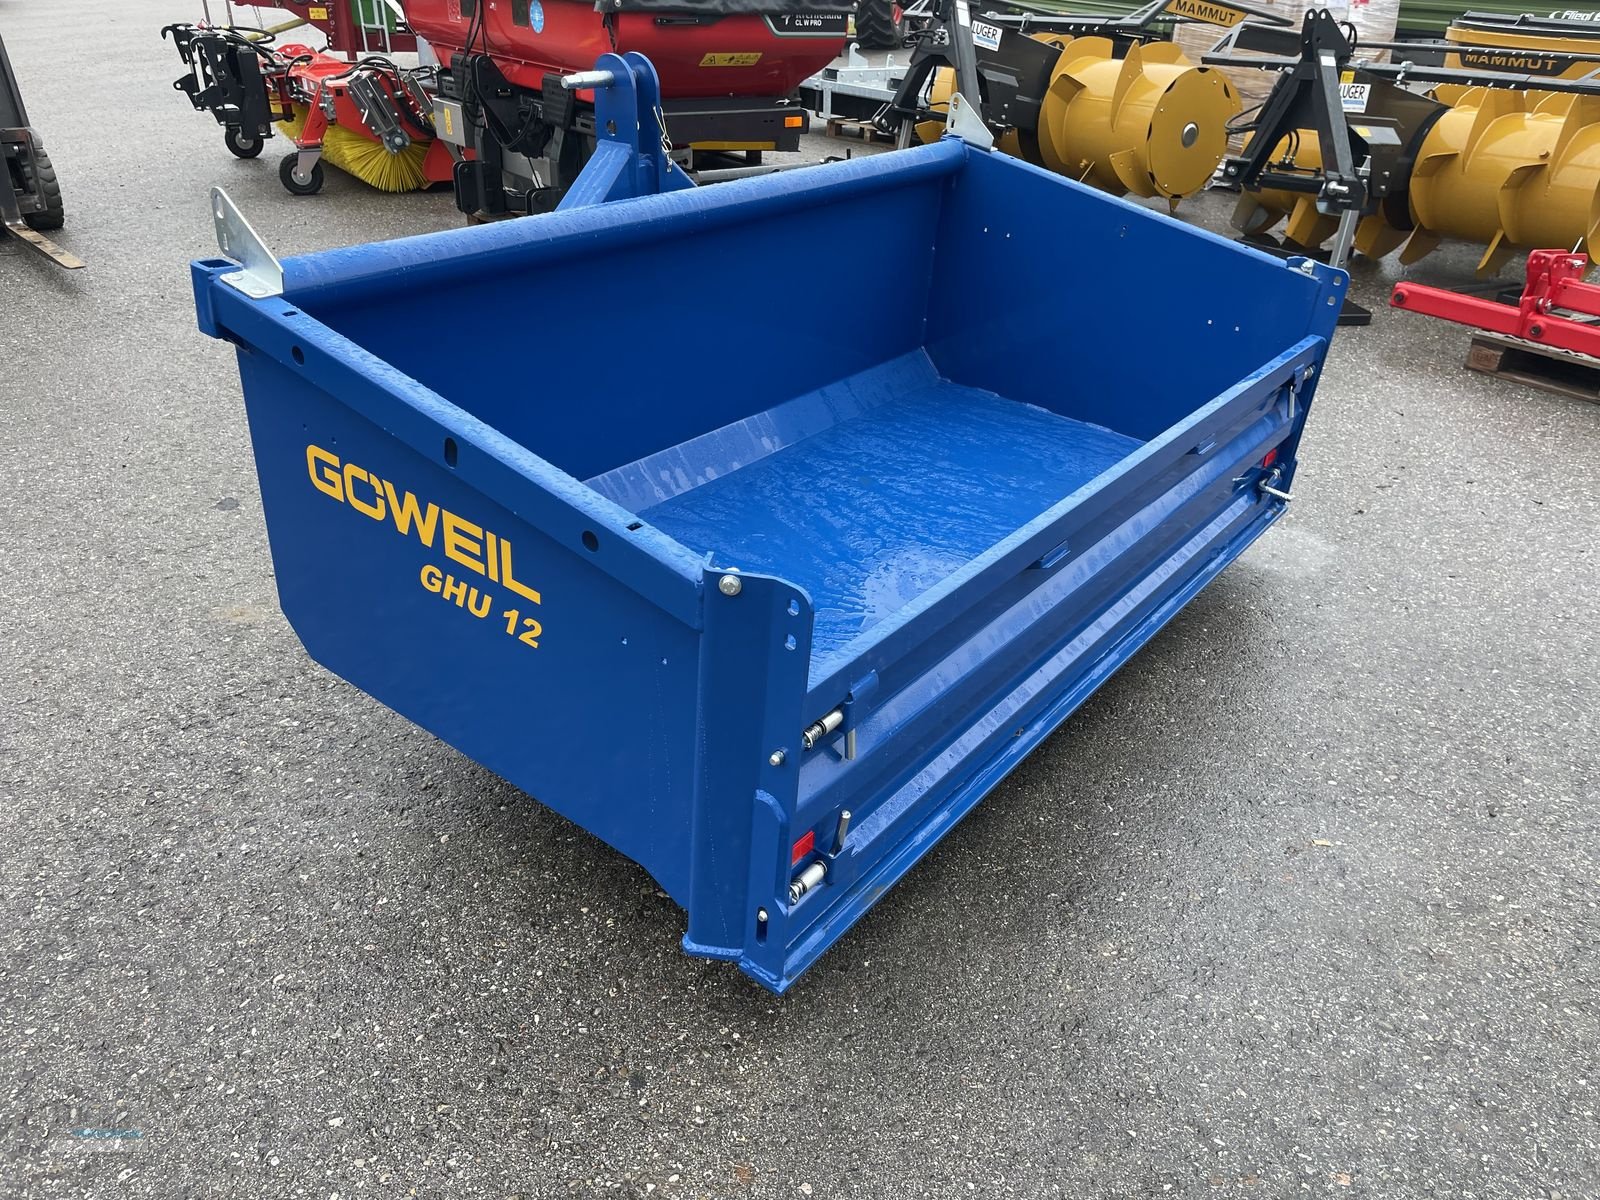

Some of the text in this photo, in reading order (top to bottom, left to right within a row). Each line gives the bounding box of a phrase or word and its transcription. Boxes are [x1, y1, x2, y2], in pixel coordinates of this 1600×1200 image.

[1175, 0, 1236, 24] MAMMUT
[1465, 54, 1558, 70] MAMMUT
[420, 564, 543, 649] GHU 12
